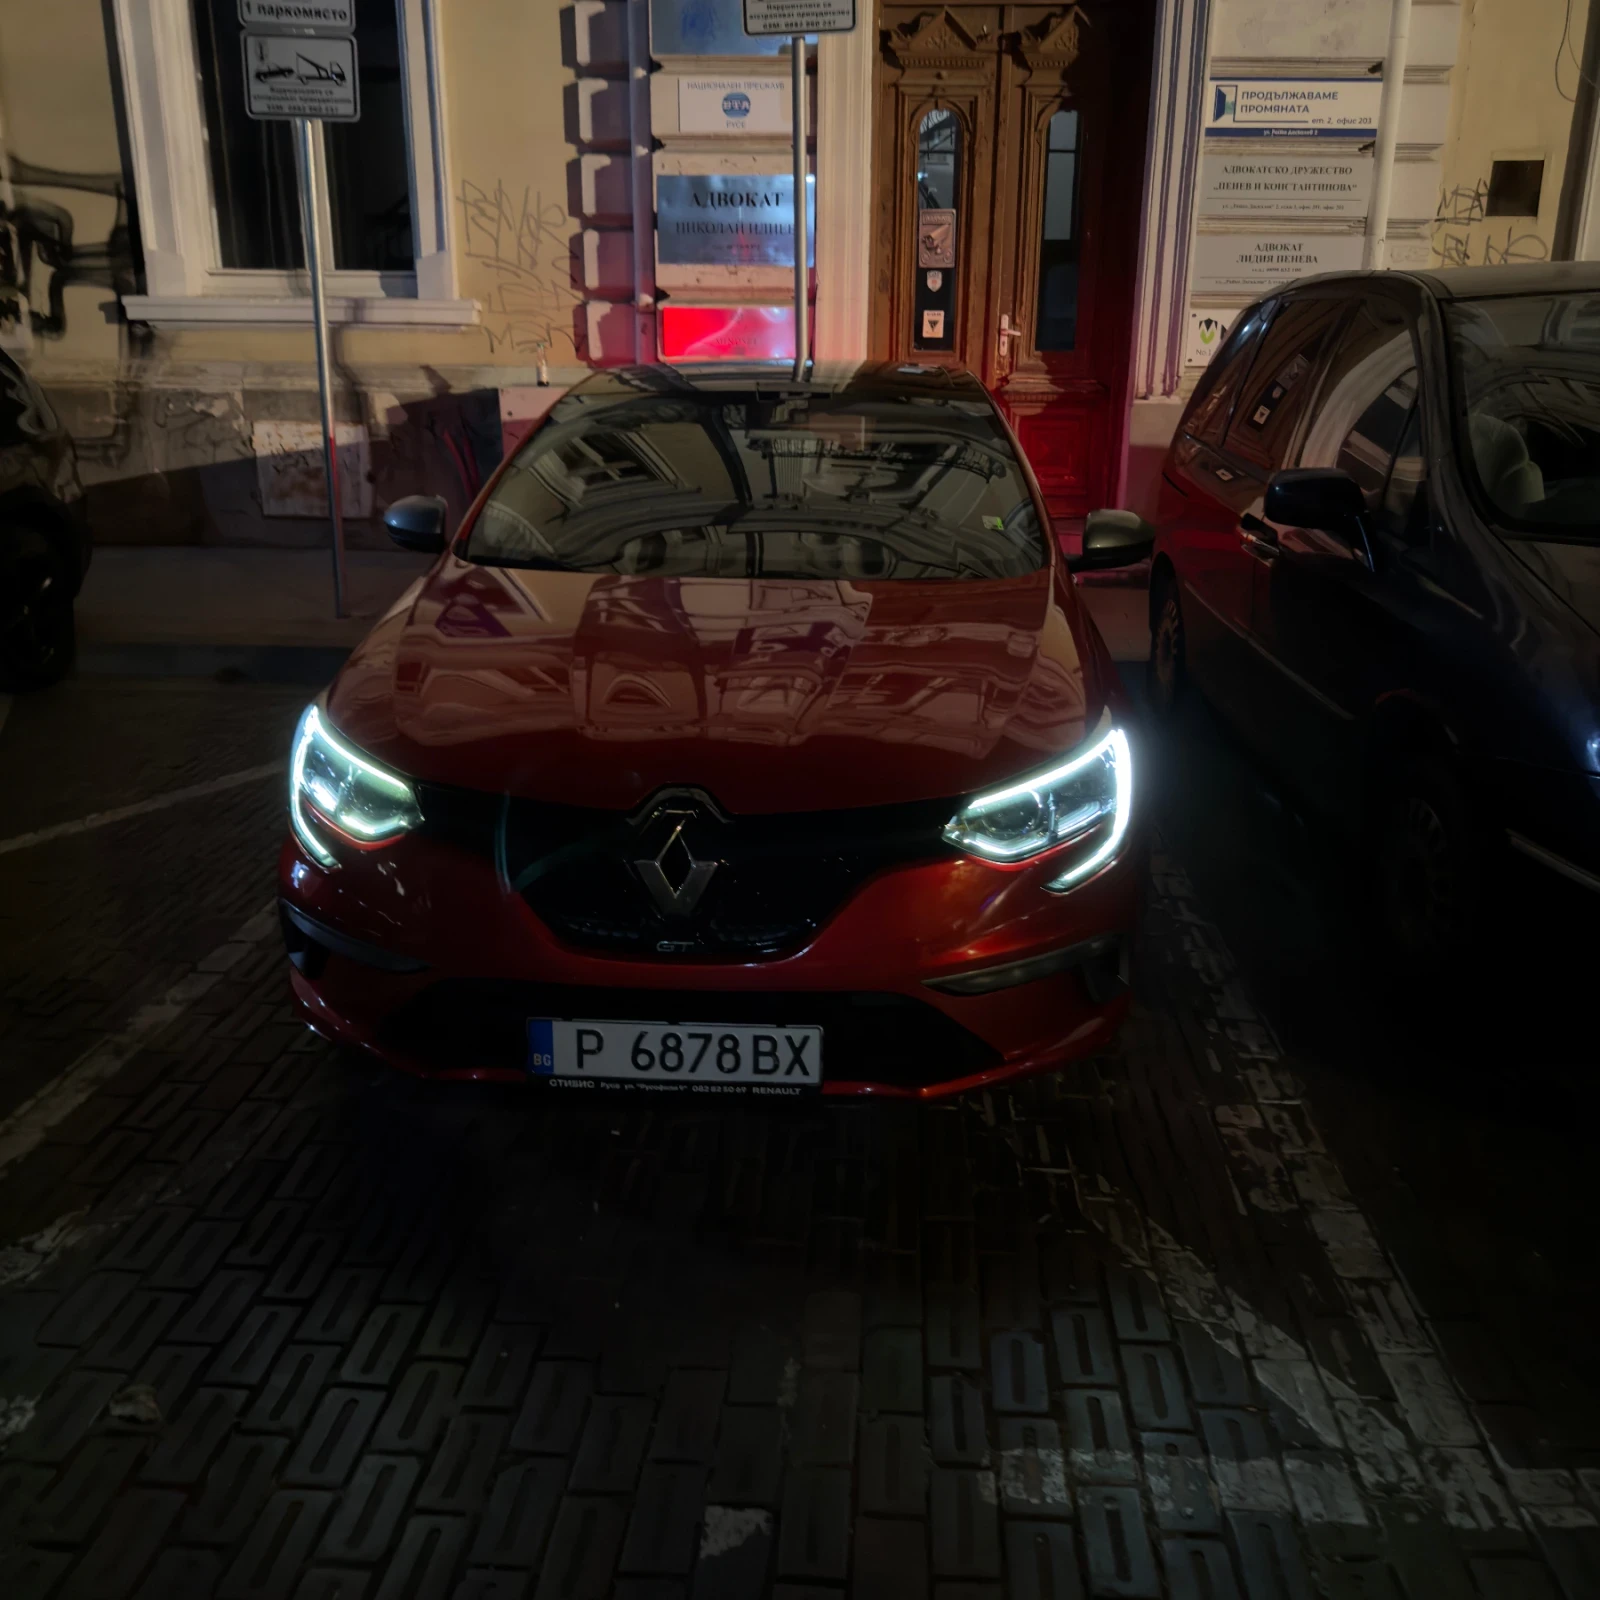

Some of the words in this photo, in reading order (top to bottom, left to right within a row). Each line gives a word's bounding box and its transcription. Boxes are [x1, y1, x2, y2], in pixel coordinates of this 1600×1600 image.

[257, 3, 348, 22] паркомясто
[1241, 91, 1339, 102] ПРОДЪЛЖАВАМЕ
[1240, 104, 1310, 114] ПРОМЯНАТА
[1336, 116, 1357, 126] офис
[1358, 117, 1372, 125] 203
[1222, 165, 1289, 175] АДВОКАТСКО
[1290, 166, 1353, 175] ДРУЖЕСТВО
[1254, 182, 1261, 191] И
[691, 192, 784, 209] АДВОКАТ
[1254, 243, 1304, 252] АДВОКАТ
[1236, 254, 1274, 264] ЛИДИЯ
[1276, 255, 1318, 264] ПЕНЕВА
[656, 940, 695, 952] GT
[533, 1053, 553, 1067] BG
[752, 1086, 803, 1096] RENAULT
